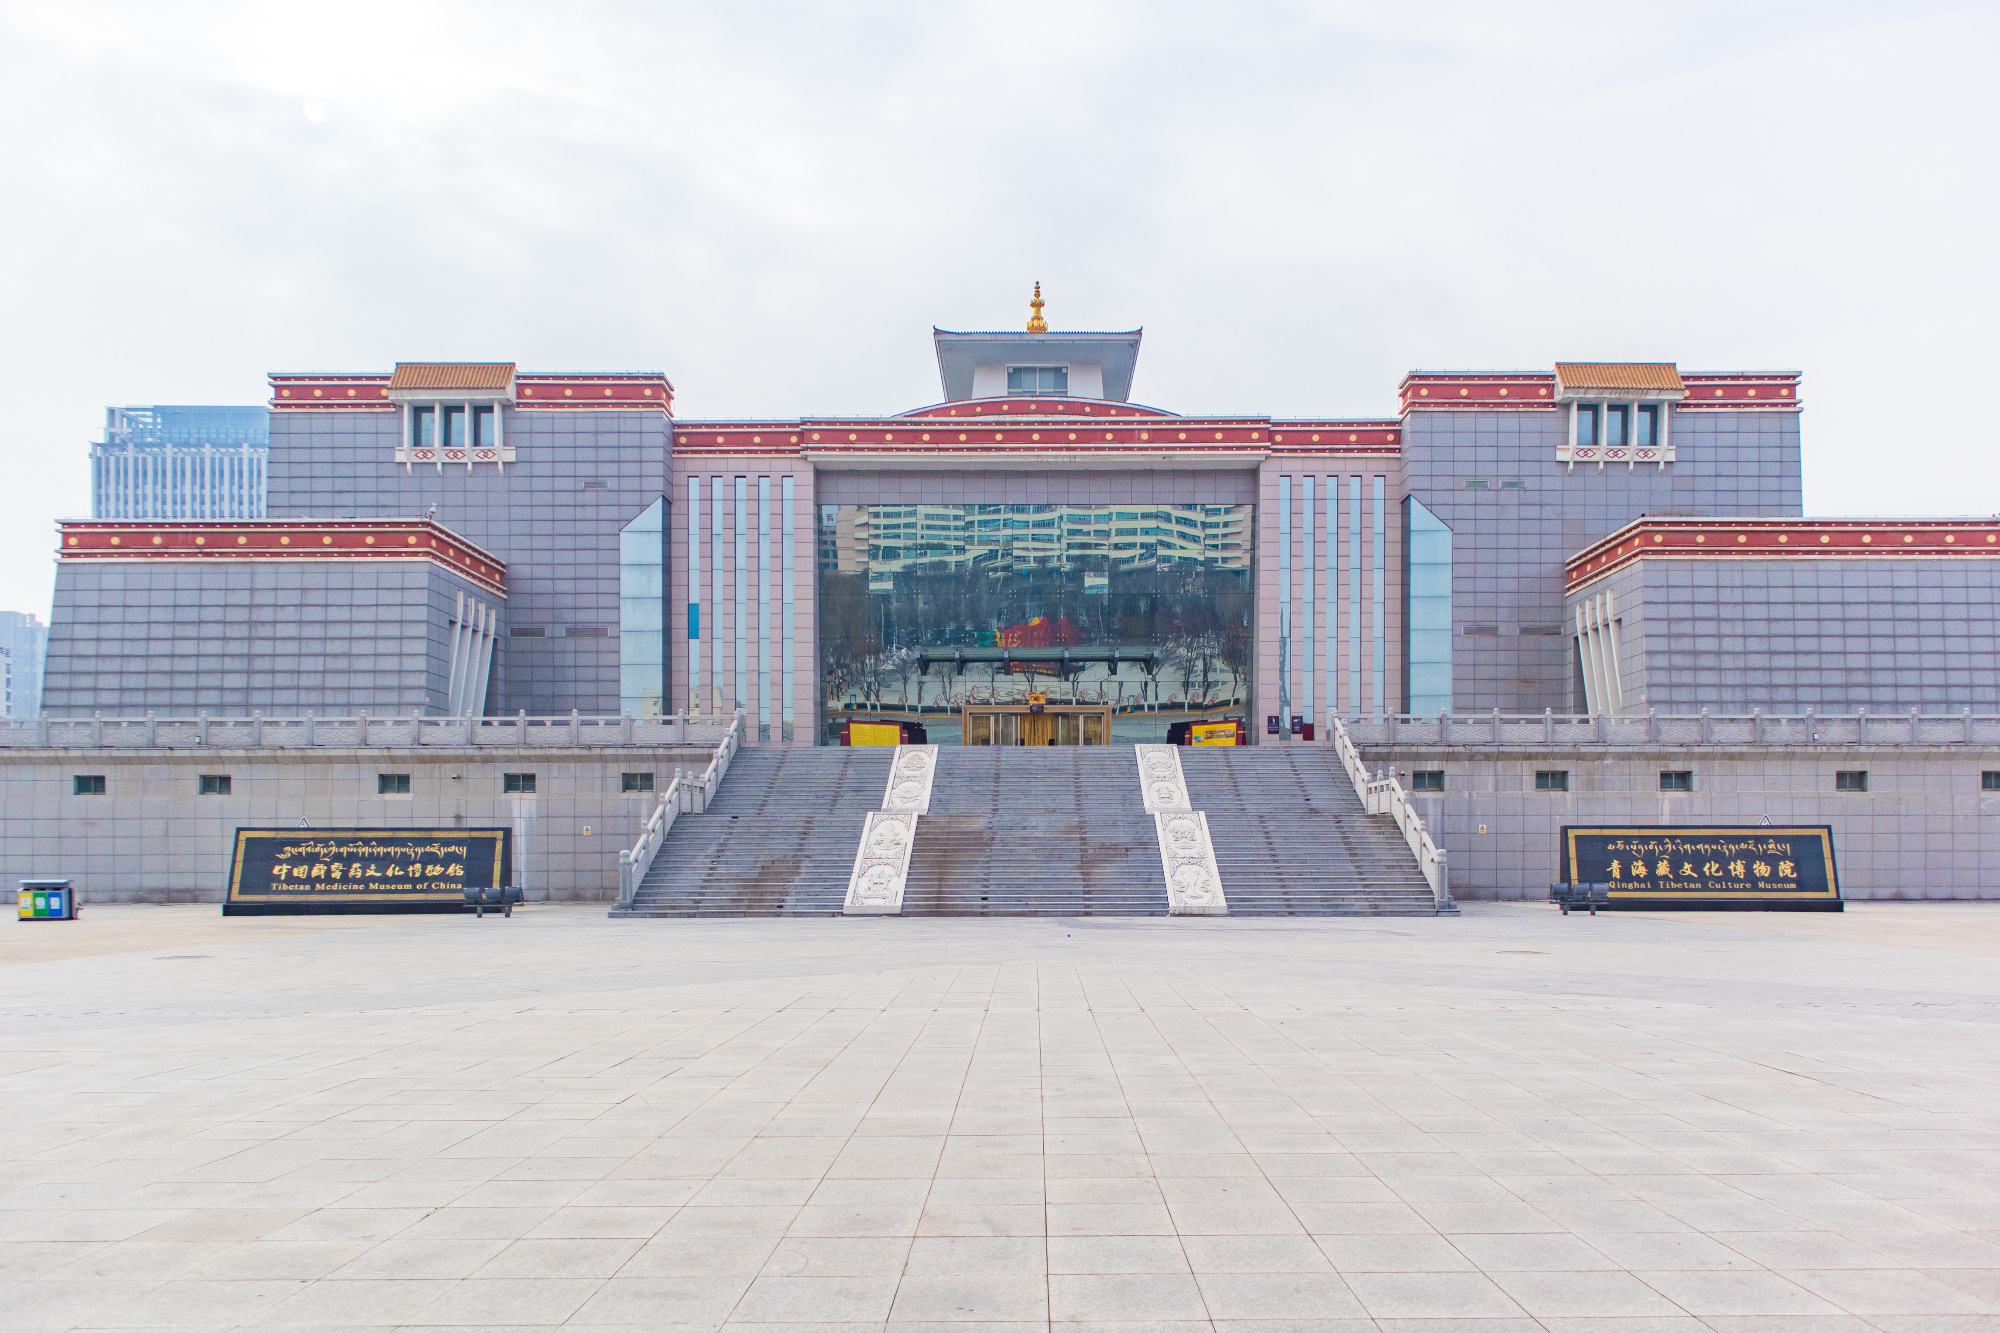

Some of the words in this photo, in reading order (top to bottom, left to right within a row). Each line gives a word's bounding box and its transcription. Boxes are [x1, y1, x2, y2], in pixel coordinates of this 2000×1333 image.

[1606, 859, 1797, 879] 青海藏文化博物院
[369, 882, 413, 890] Museum
[416, 882, 429, 890] of
[431, 882, 463, 890] China
[1609, 881, 1652, 889] Qinghai
[1659, 881, 1702, 889] Tibetan
[1708, 881, 1752, 889] Culture
[1758, 881, 1797, 889] Museum
